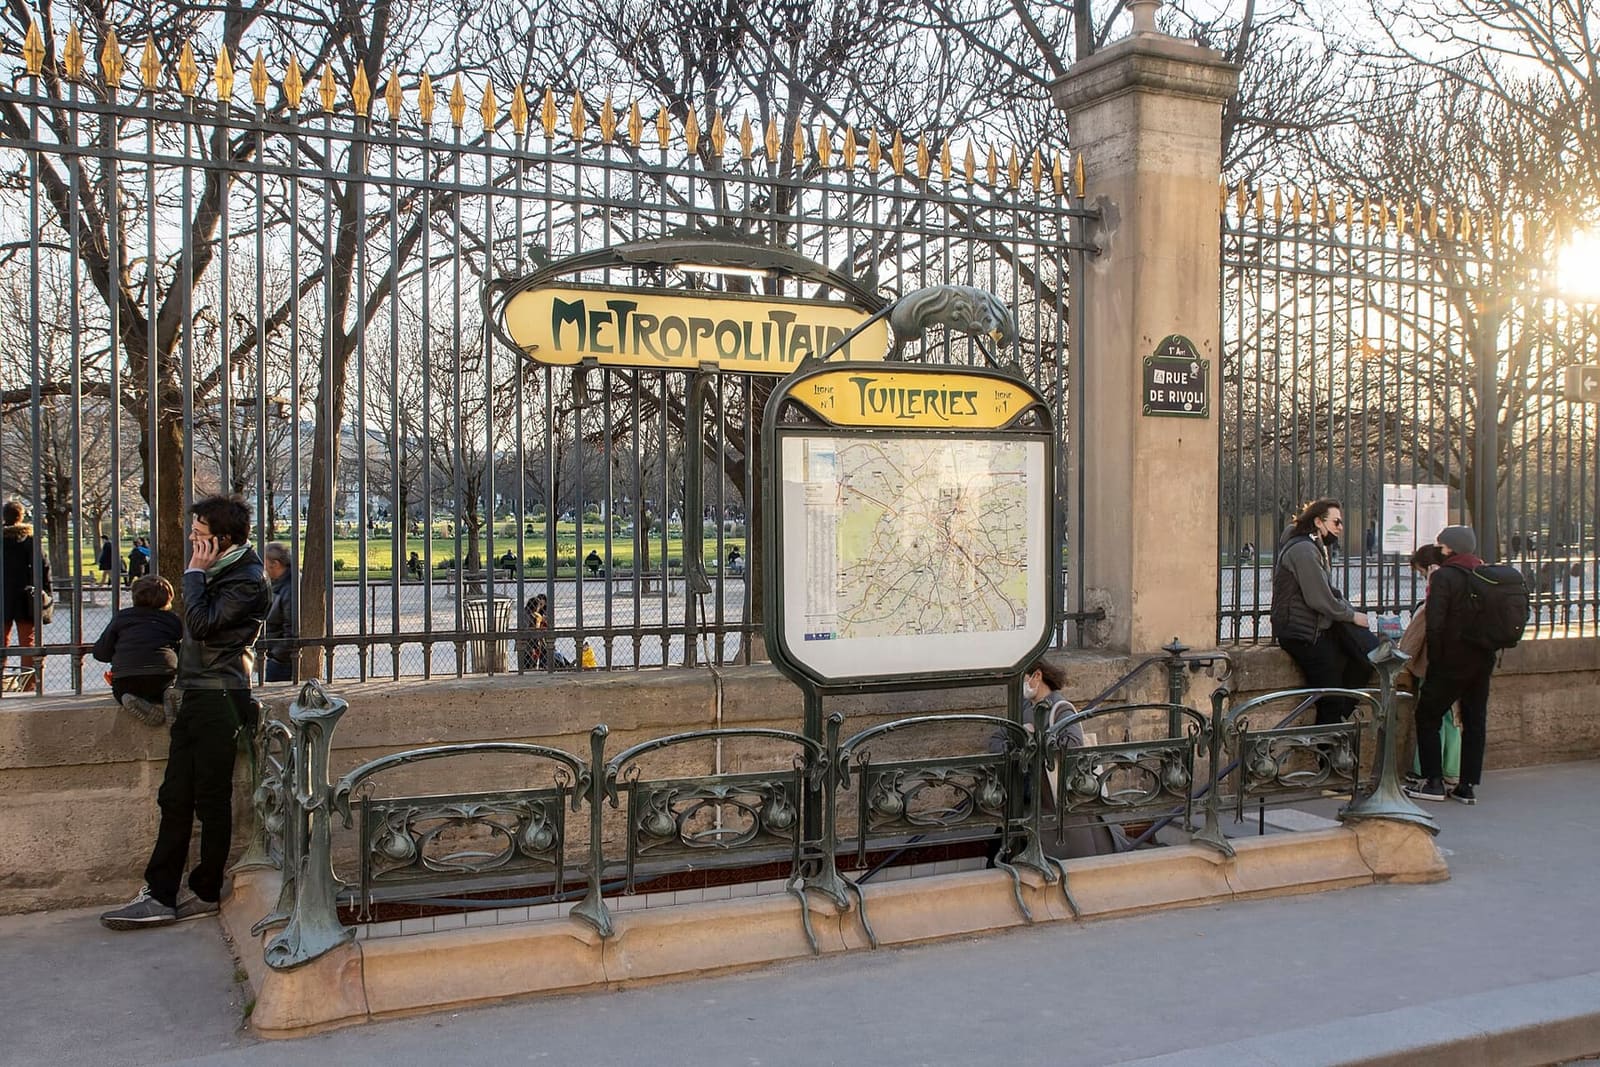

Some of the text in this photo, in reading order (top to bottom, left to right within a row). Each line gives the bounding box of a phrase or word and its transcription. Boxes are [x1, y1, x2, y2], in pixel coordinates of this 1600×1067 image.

[552, 297, 851, 362] METROPOLITAIN
[1165, 371, 1188, 384] RUE
[848, 377, 978, 421] TUILERIES
[1150, 389, 1204, 404] DE RIVOLI
